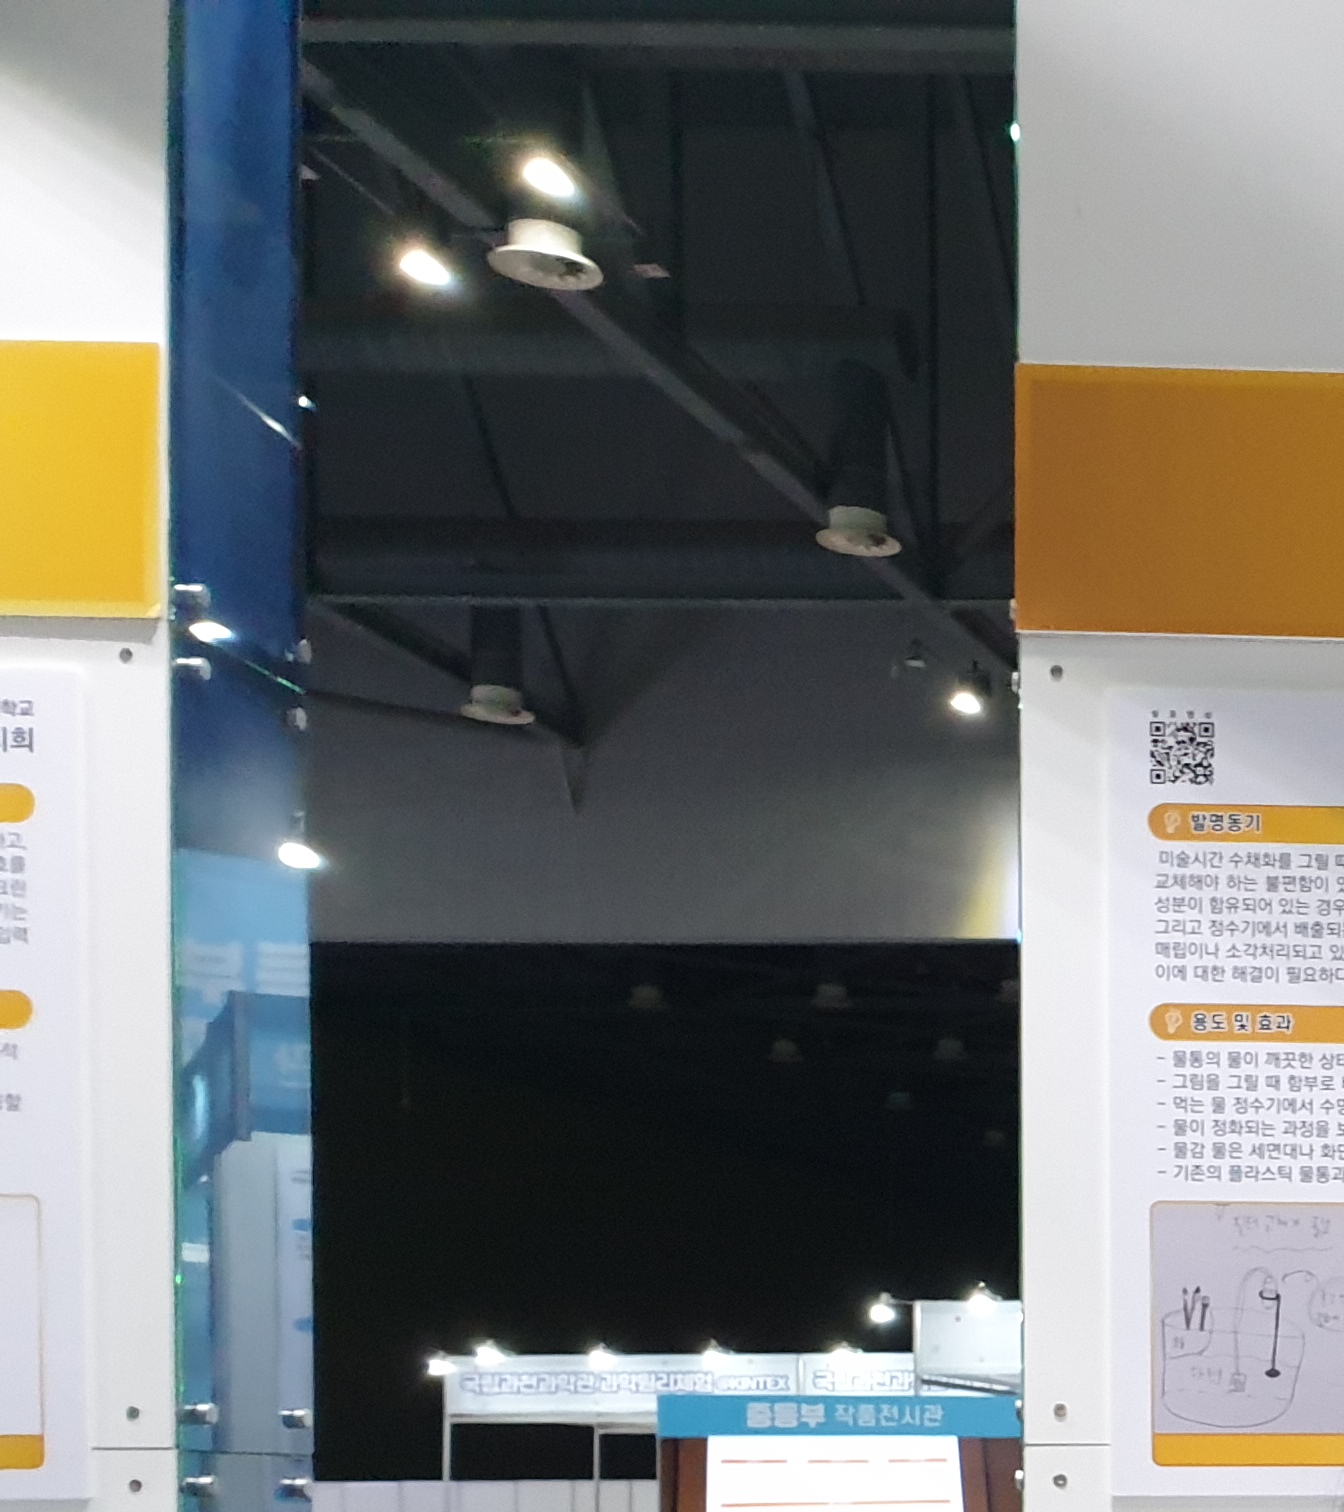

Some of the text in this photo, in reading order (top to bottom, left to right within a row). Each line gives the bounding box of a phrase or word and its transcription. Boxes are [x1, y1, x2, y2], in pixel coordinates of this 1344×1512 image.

[1191, 813, 1260, 832] 발명동기
[1194, 1013, 1291, 1031] 용도 및 효과
[835, 1403, 944, 1428] 작품전시관
